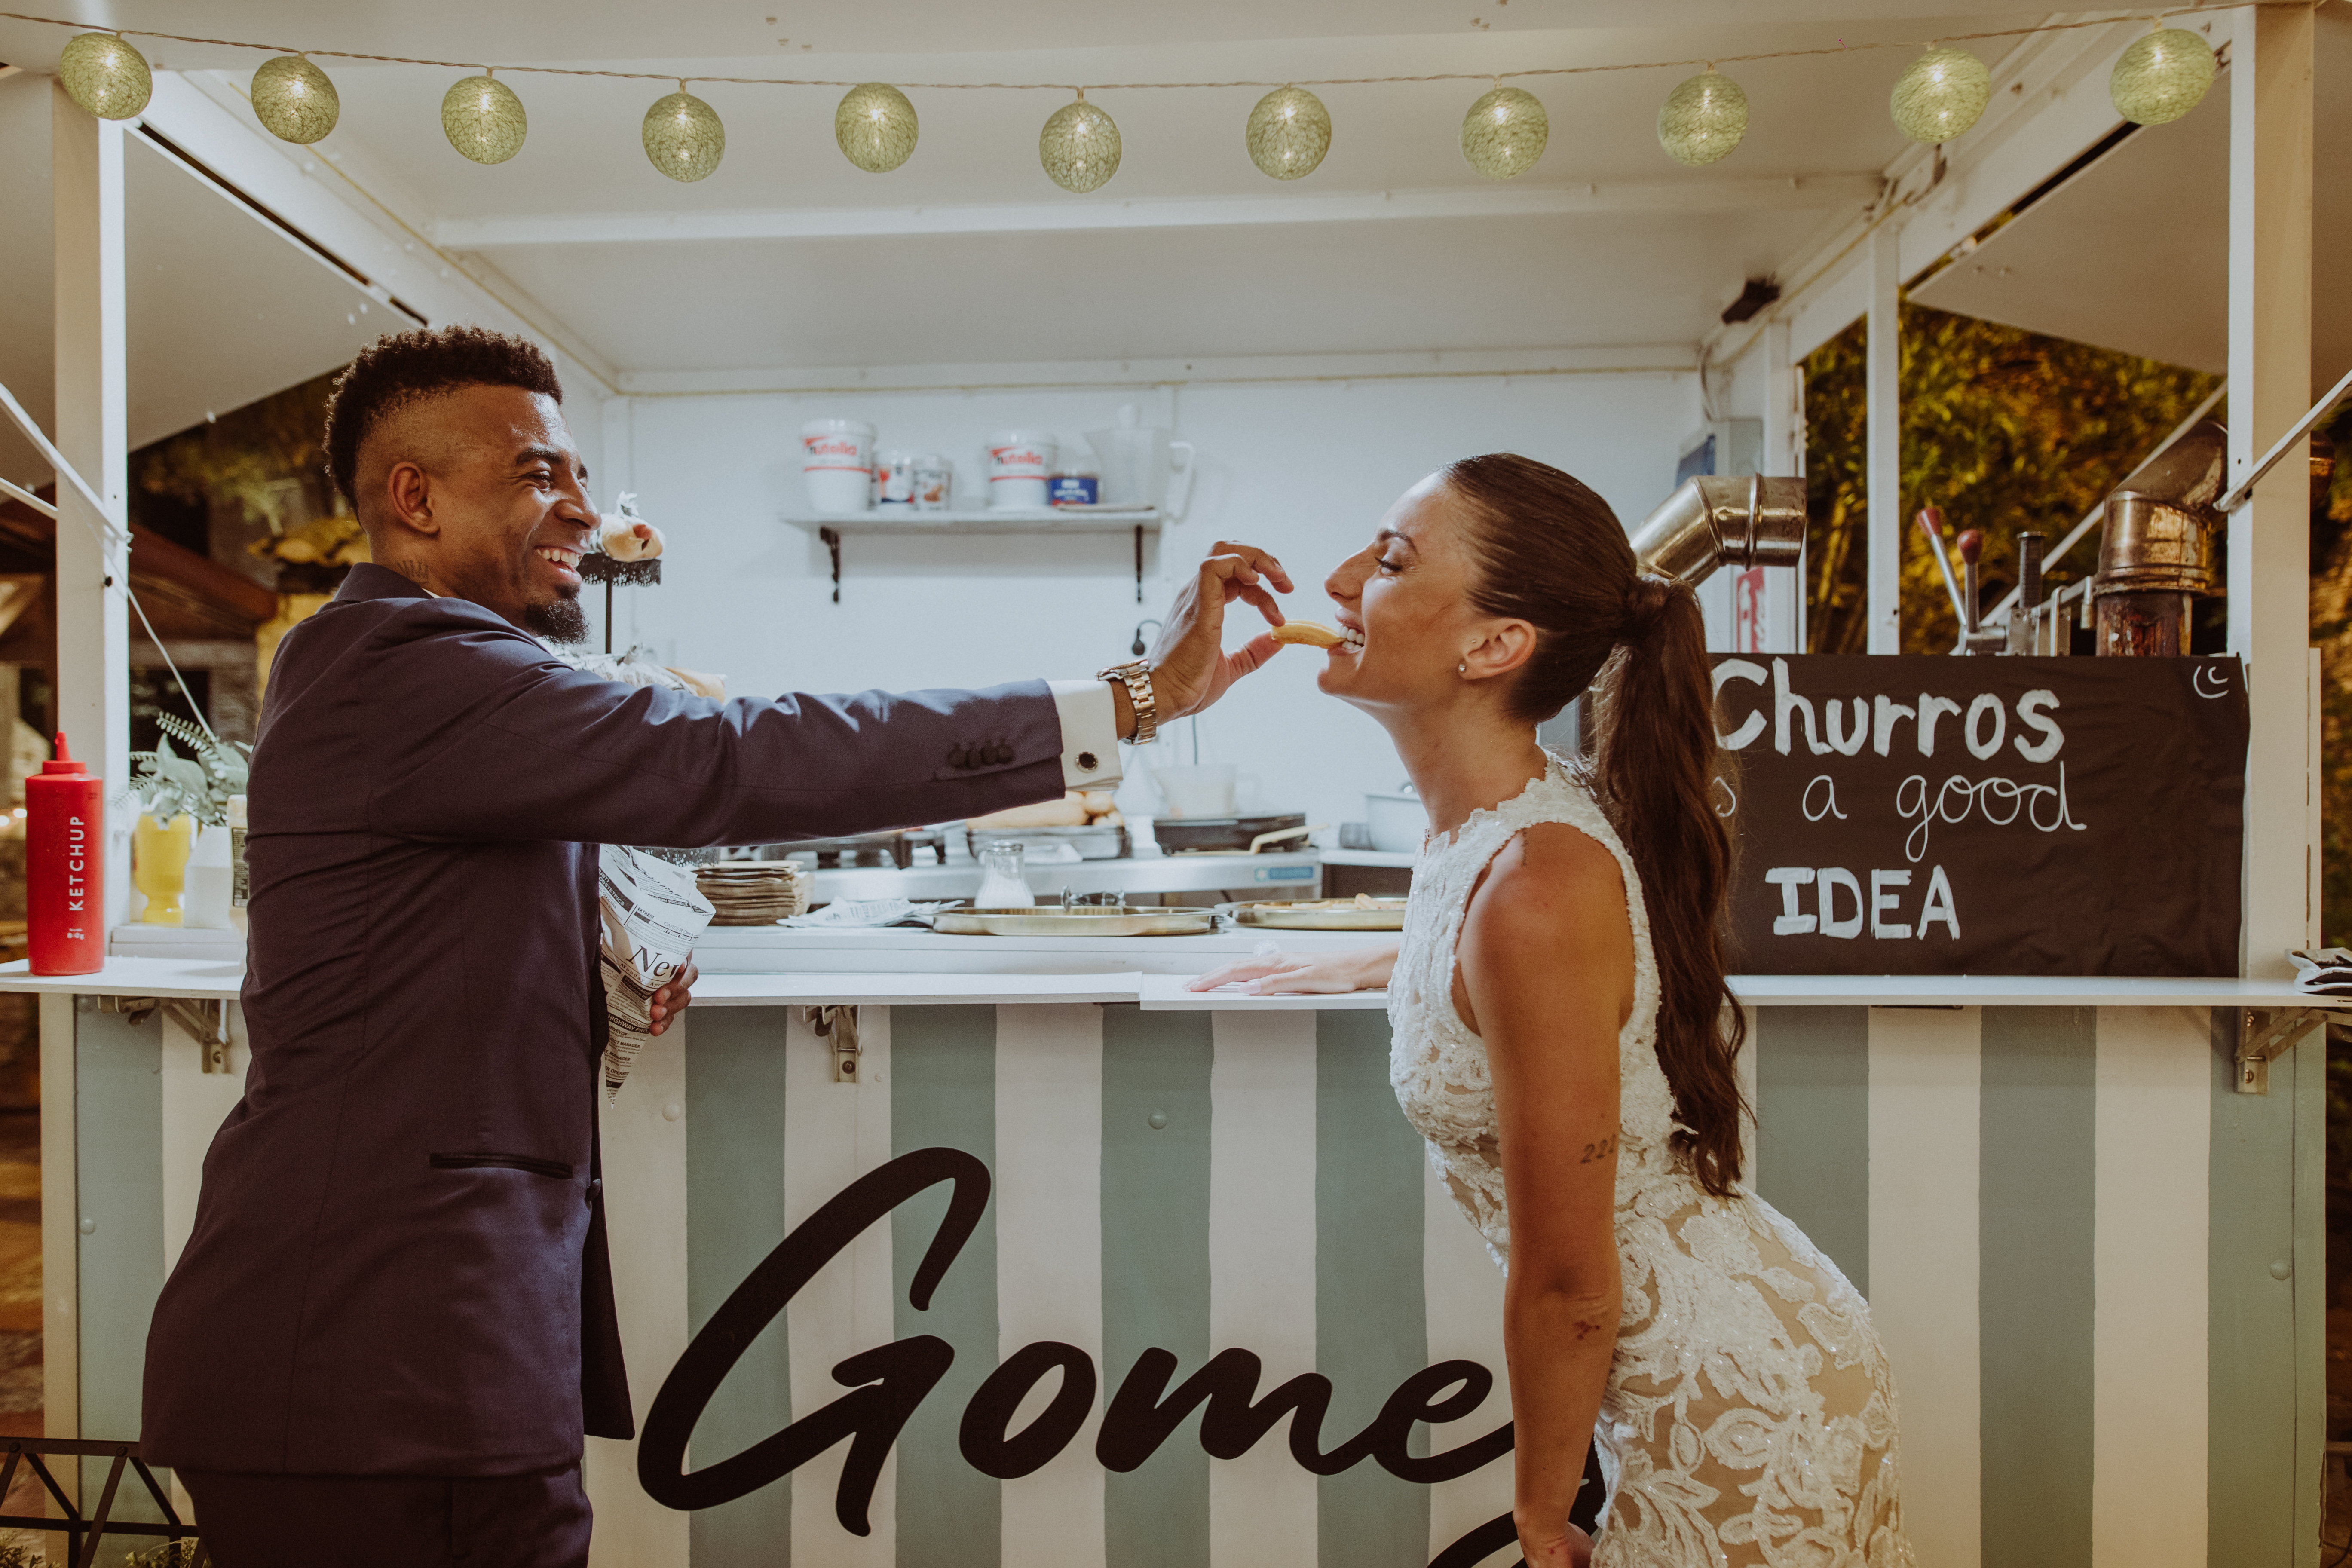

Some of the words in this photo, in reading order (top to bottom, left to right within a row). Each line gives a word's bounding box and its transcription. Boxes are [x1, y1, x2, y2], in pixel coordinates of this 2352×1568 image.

[1710, 657, 2065, 764] Churros
[1802, 775, 1847, 821] a
[1896, 760, 2087, 863] good
[69, 816, 85, 911] KETCHUP
[599, 876, 624, 906] OBSTETRICS
[1765, 865, 1961, 940] IDEA
[648, 919, 668, 933] Manager
[664, 921, 683, 932] CAREER
[608, 1014, 635, 1030] HIGHWAY
[609, 1025, 628, 1035] RVEYOR
[621, 1014, 643, 1027] REQUIRED
[609, 1051, 630, 1061] MANAGER
[637, 1146, 1608, 1568] Gome
